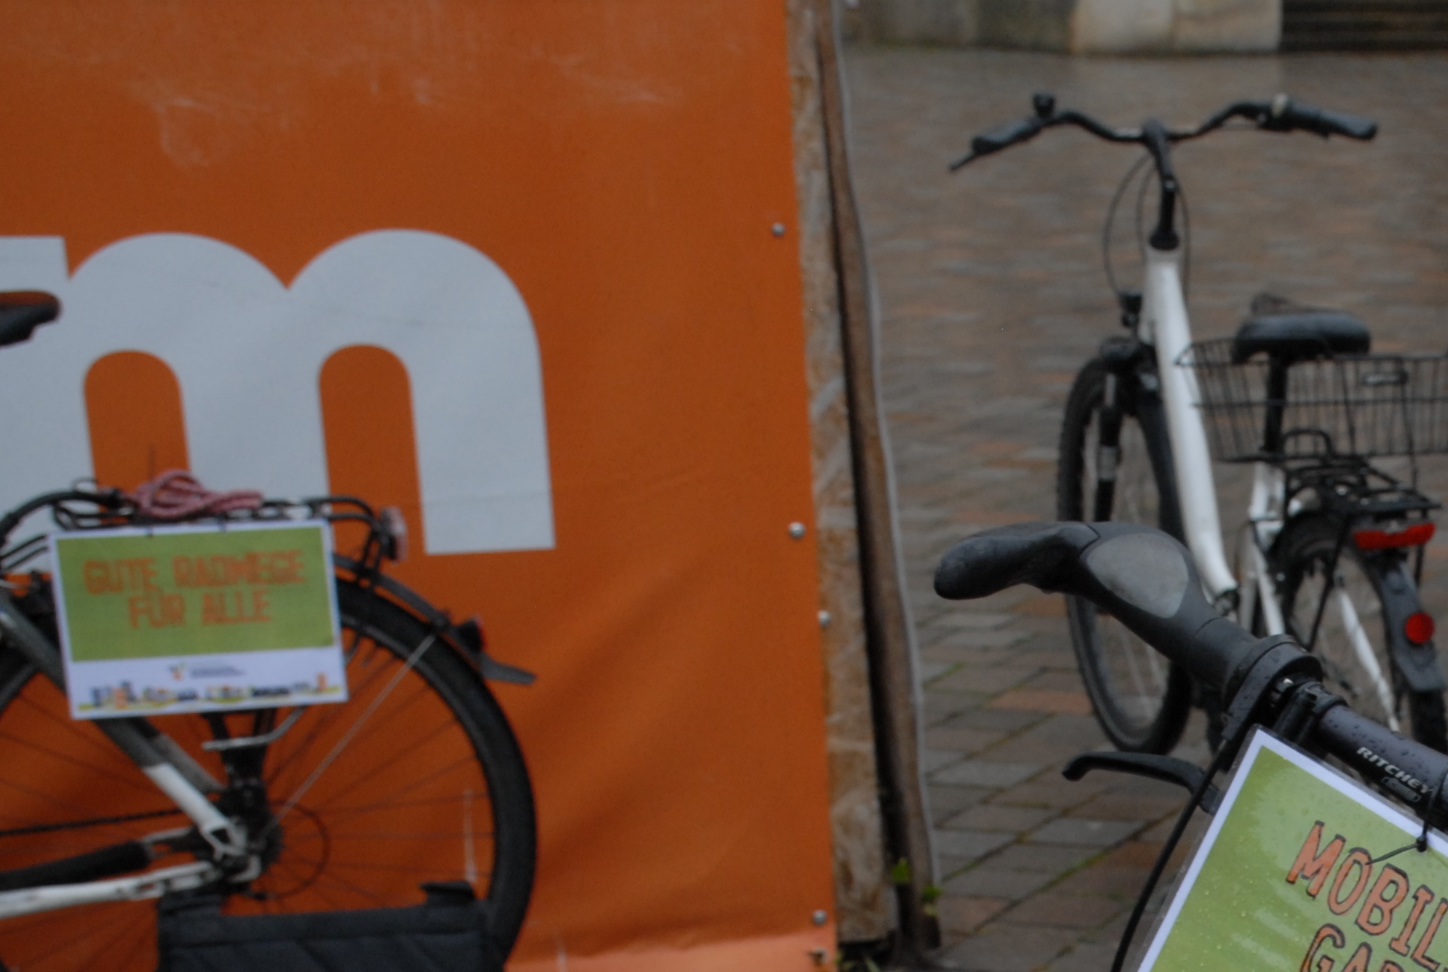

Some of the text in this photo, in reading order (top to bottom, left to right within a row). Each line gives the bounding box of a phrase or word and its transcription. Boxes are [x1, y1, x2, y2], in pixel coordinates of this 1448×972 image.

[83, 549, 306, 596] GUTE RADWEGE
[202, 589, 272, 625] ALLE
[1356, 746, 1434, 795] RITCHEY
